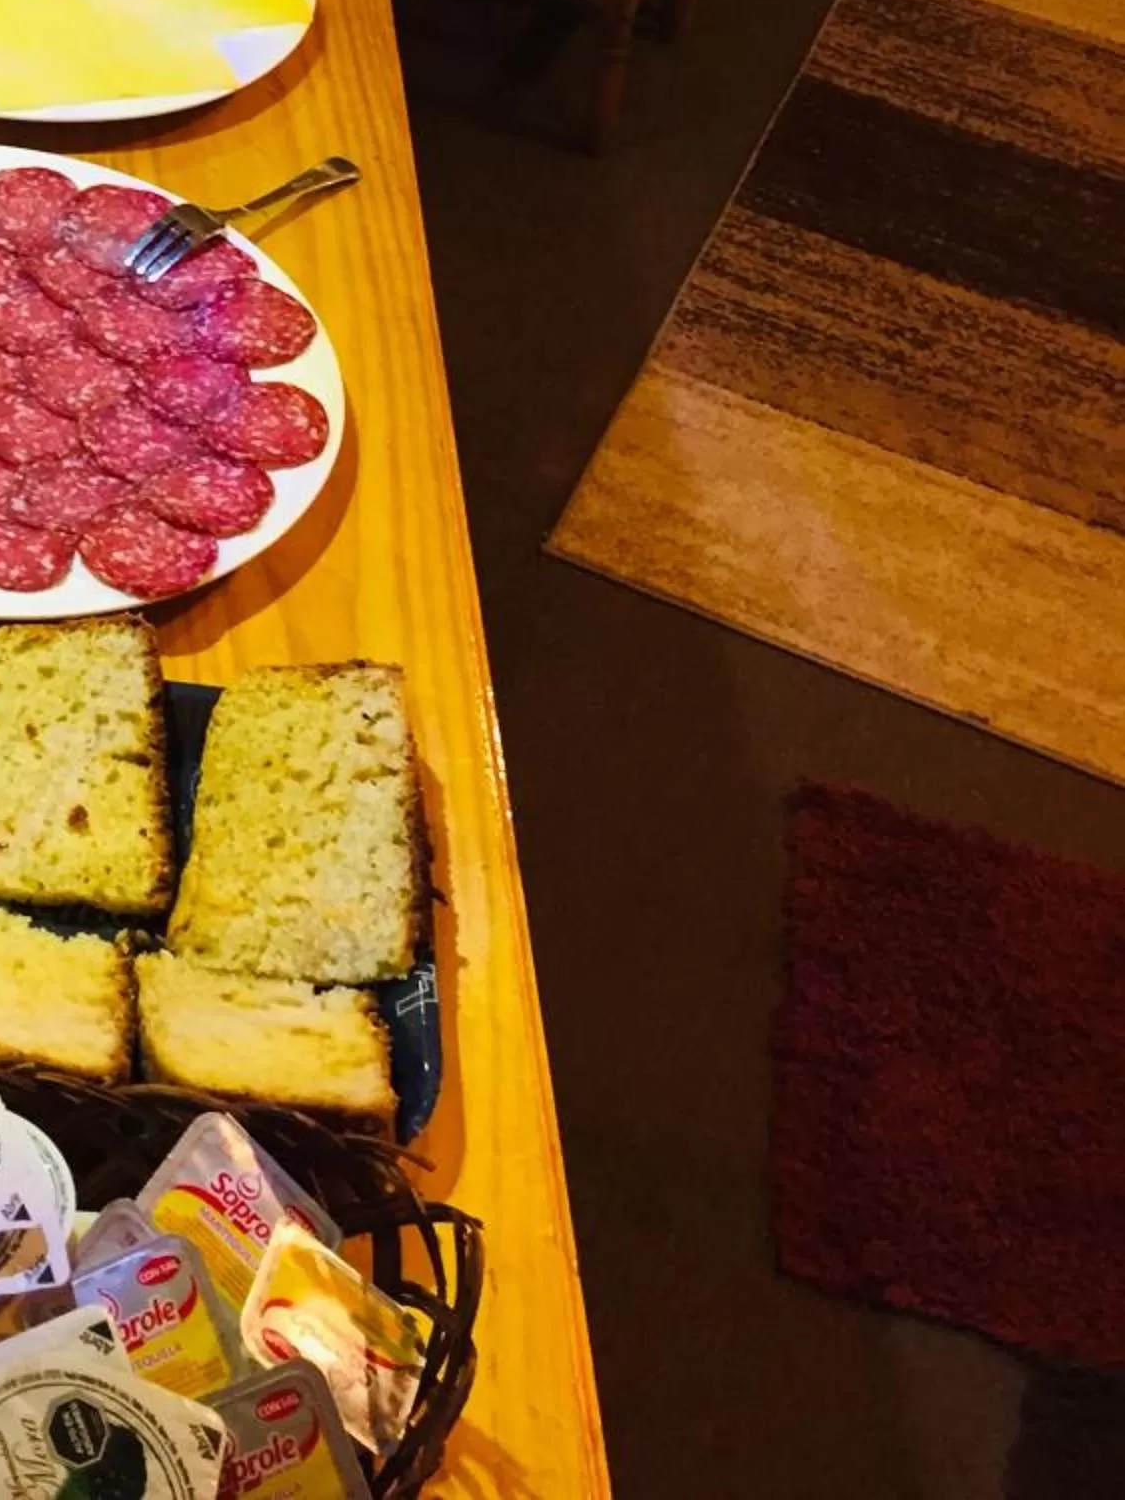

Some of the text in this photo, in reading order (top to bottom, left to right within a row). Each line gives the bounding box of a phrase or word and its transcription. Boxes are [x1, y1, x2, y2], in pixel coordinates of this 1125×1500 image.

[211, 1171, 272, 1243] Sopro
[117, 1299, 176, 1346] prole
[13, 1417, 60, 1499] Mora
[231, 1435, 296, 1493] prole
